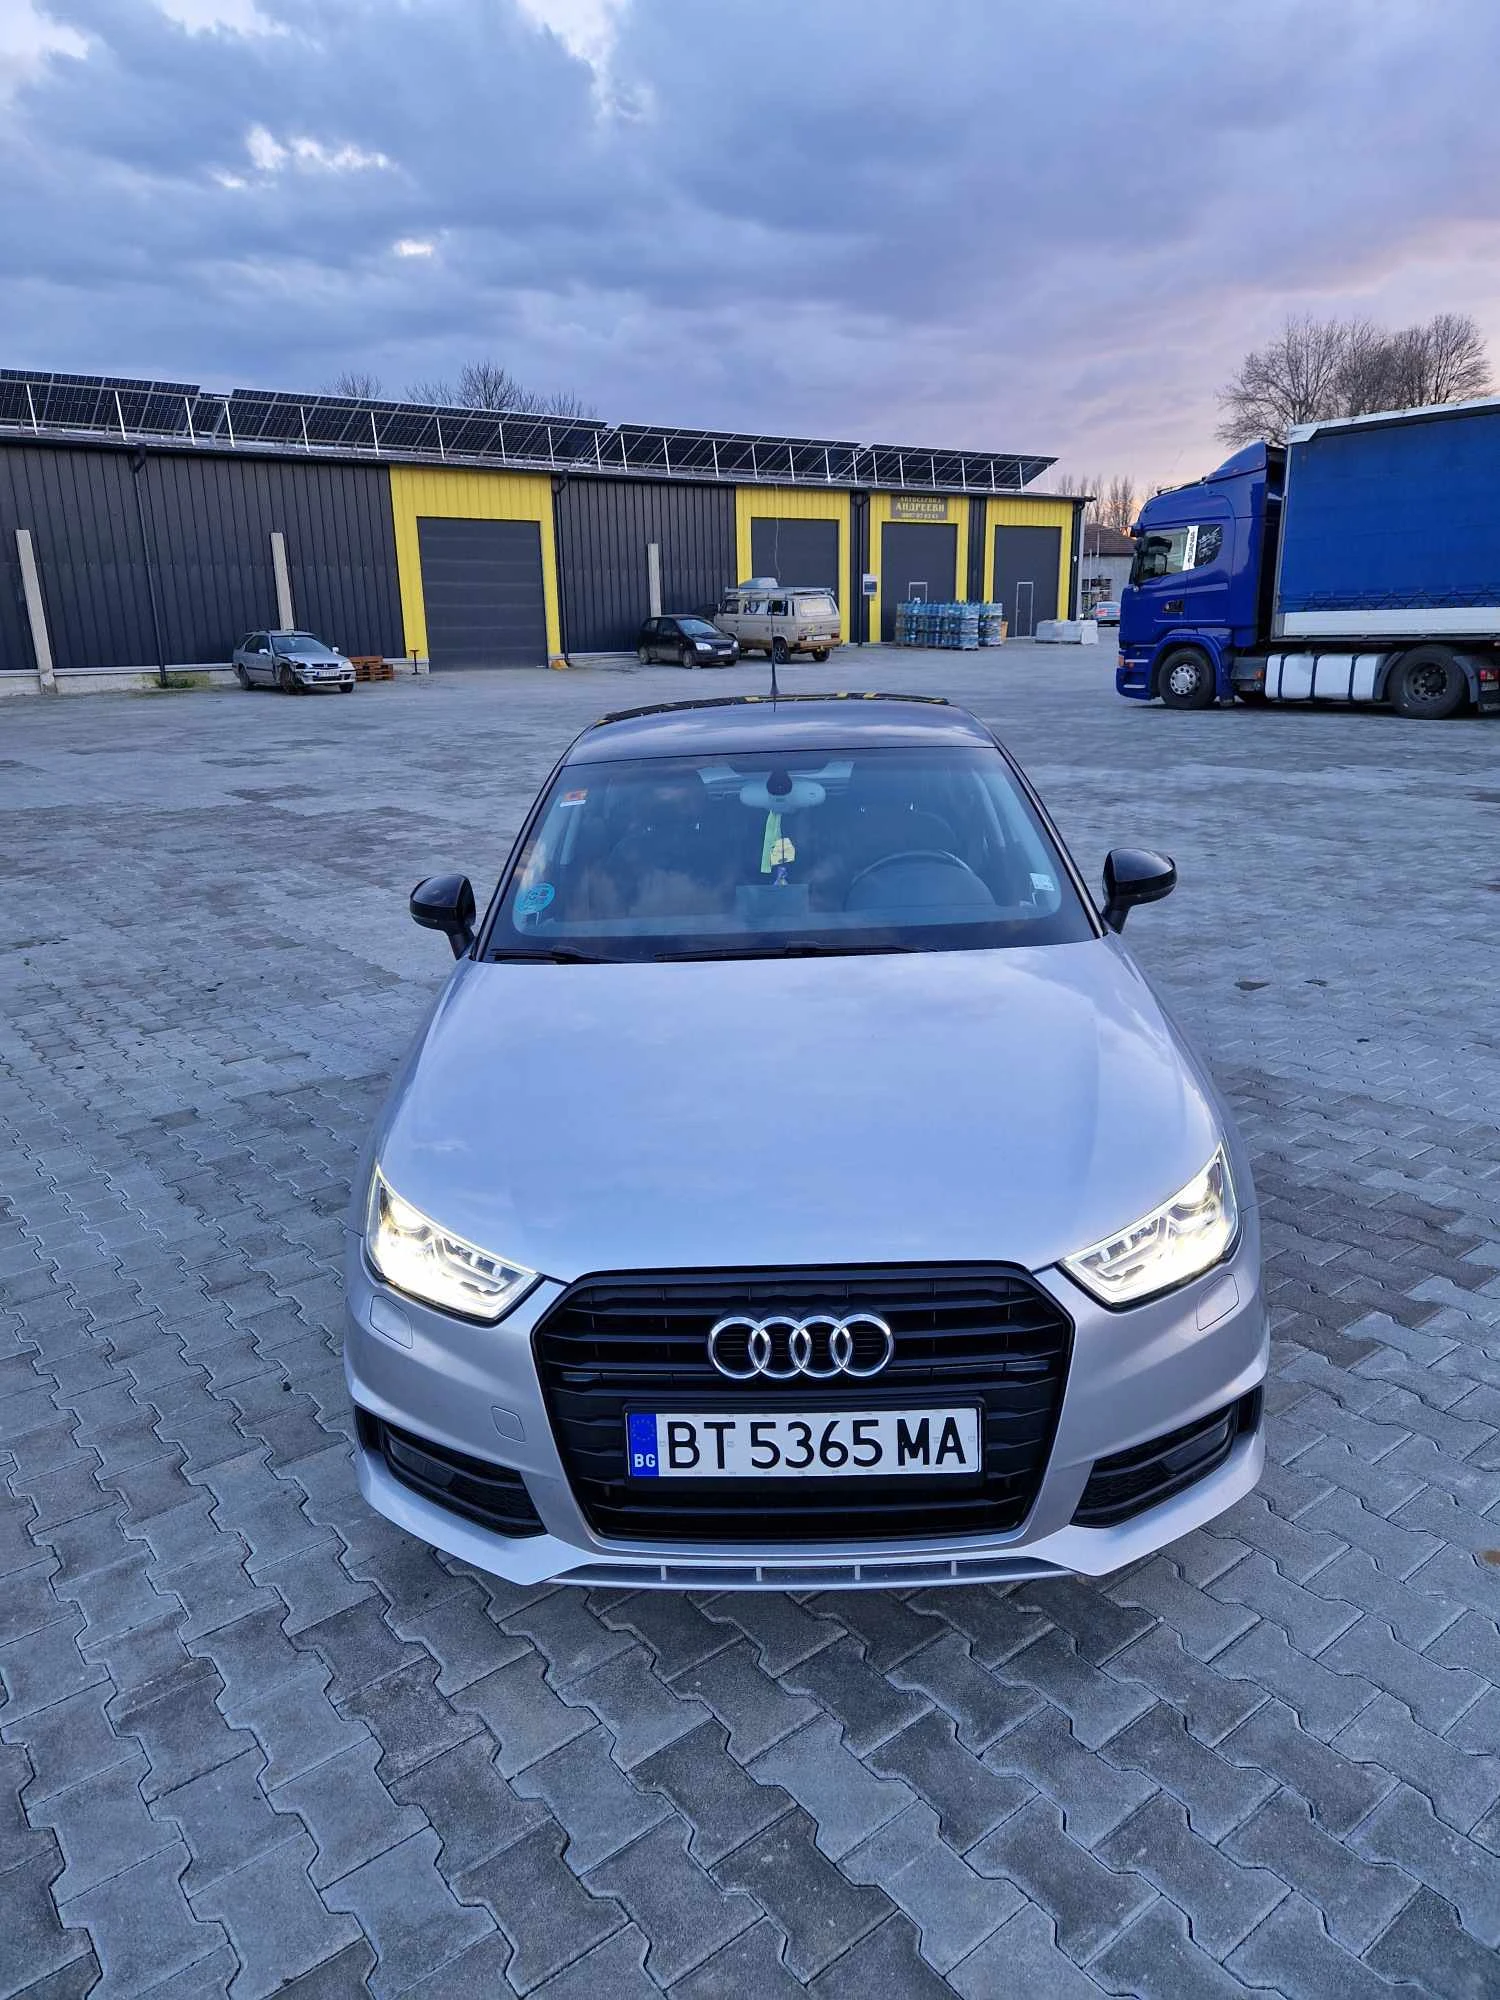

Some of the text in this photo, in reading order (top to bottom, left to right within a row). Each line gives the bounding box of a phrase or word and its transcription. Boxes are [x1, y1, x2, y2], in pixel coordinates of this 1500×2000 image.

[895, 502, 945, 512] АНДРЕЕВИ
[667, 1416, 967, 1469] BT 5365 MA
[634, 1453, 656, 1468] BG
